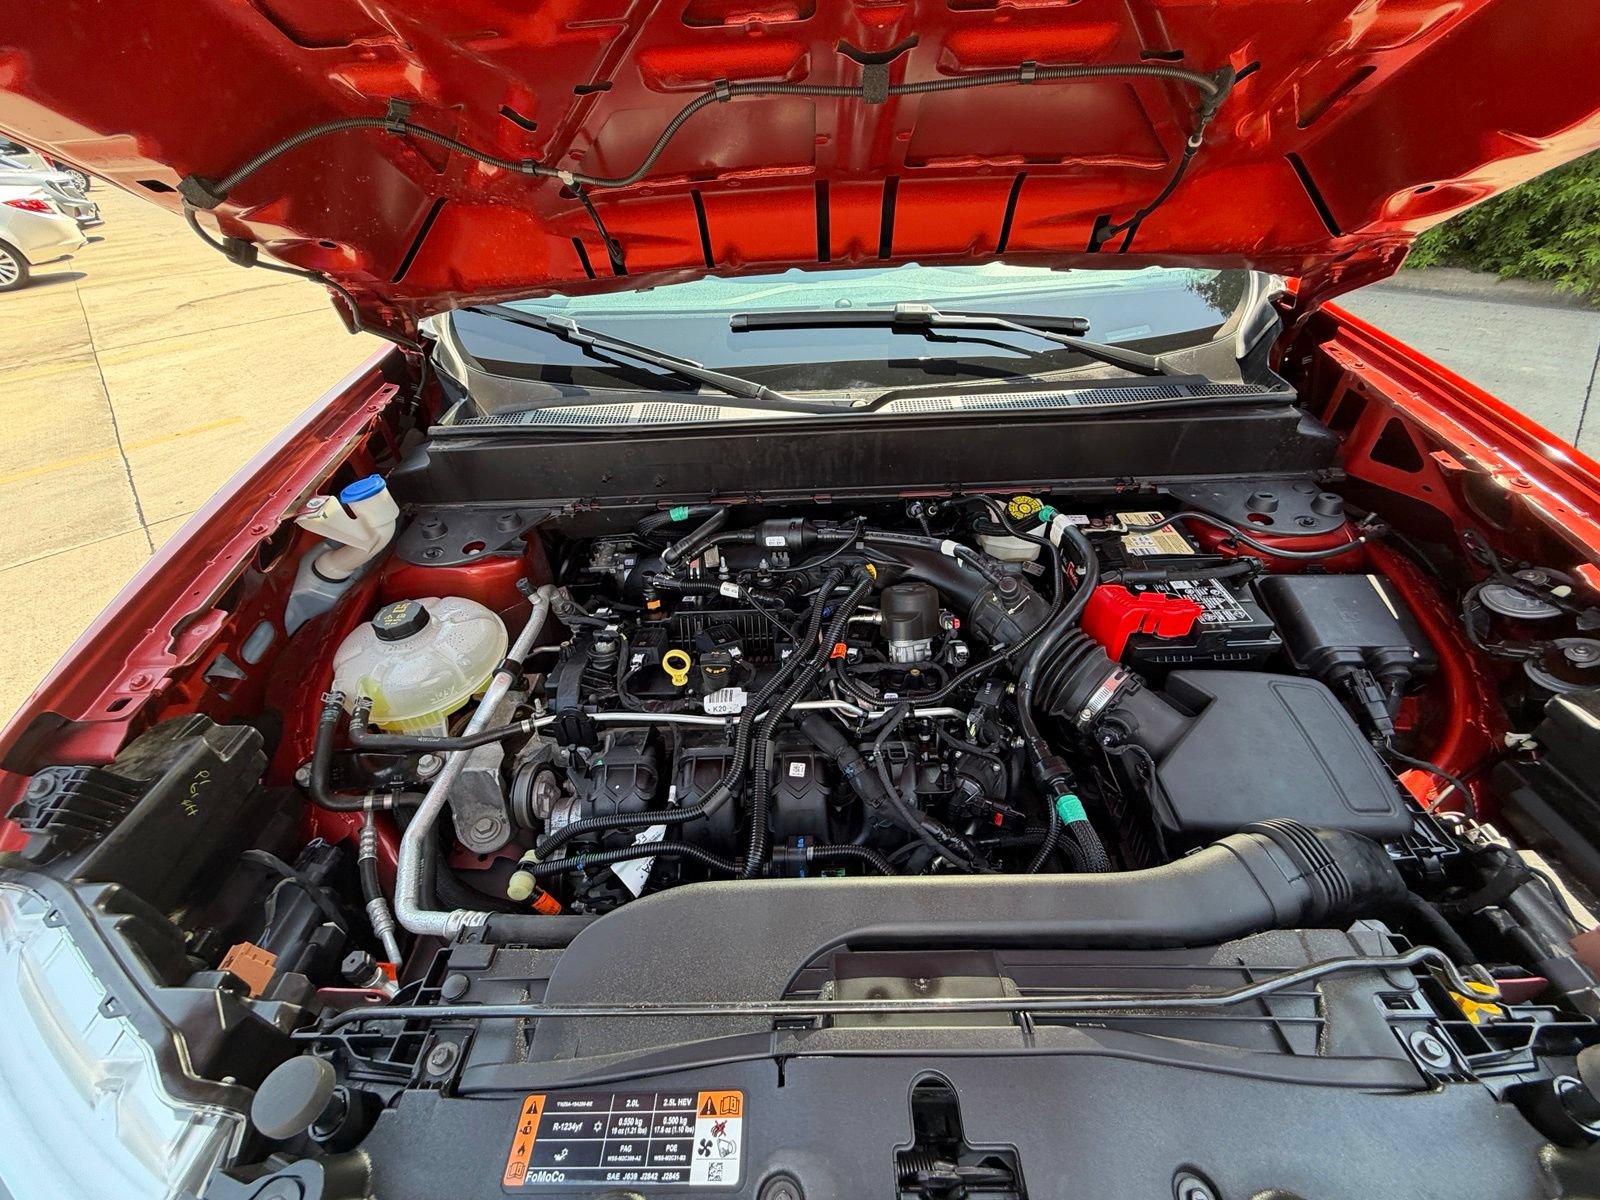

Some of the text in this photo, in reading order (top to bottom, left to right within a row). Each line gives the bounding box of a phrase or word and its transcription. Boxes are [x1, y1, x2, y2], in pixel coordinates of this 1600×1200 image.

[626, 1099, 640, 1107] 2.0L
[663, 1098, 692, 1107] 2.5L HEV
[634, 1117, 643, 1127] kg
[679, 1116, 688, 1126] kg
[552, 1121, 583, 1132] R-1234yf
[619, 1144, 633, 1153] PAG
[525, 1170, 565, 1183] FoMoCo
[622, 1172, 638, 1180] J639
